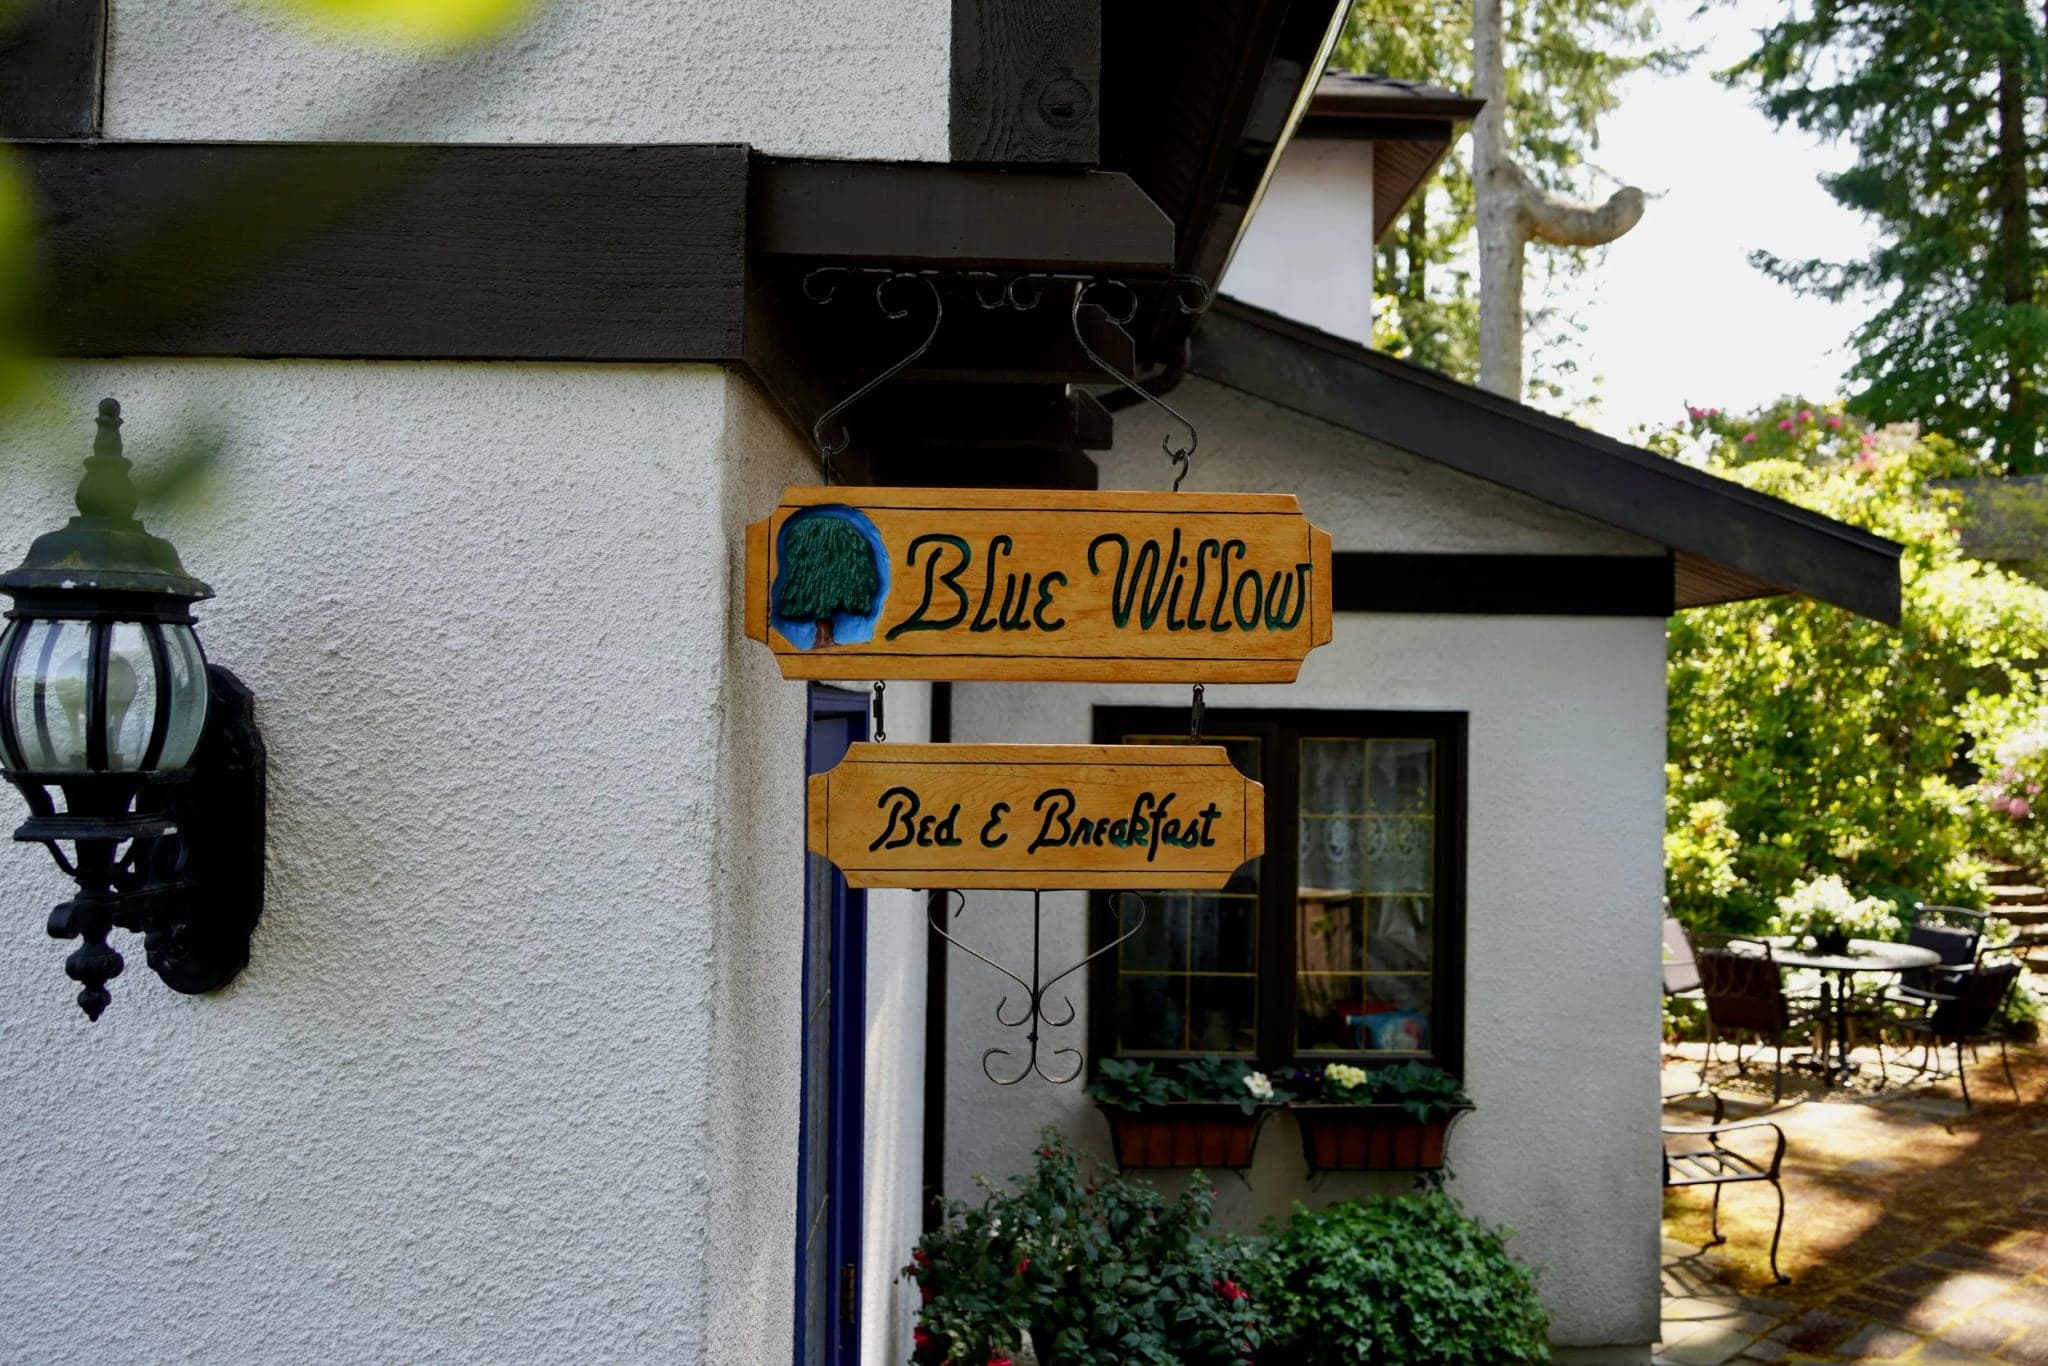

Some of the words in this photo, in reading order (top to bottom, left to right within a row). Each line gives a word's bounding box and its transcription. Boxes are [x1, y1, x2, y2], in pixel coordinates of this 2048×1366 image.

[885, 533, 1067, 641] Blue
[1088, 528, 1312, 632] Willow
[869, 787, 961, 851] Bed
[1027, 788, 1221, 862] Breakfast
